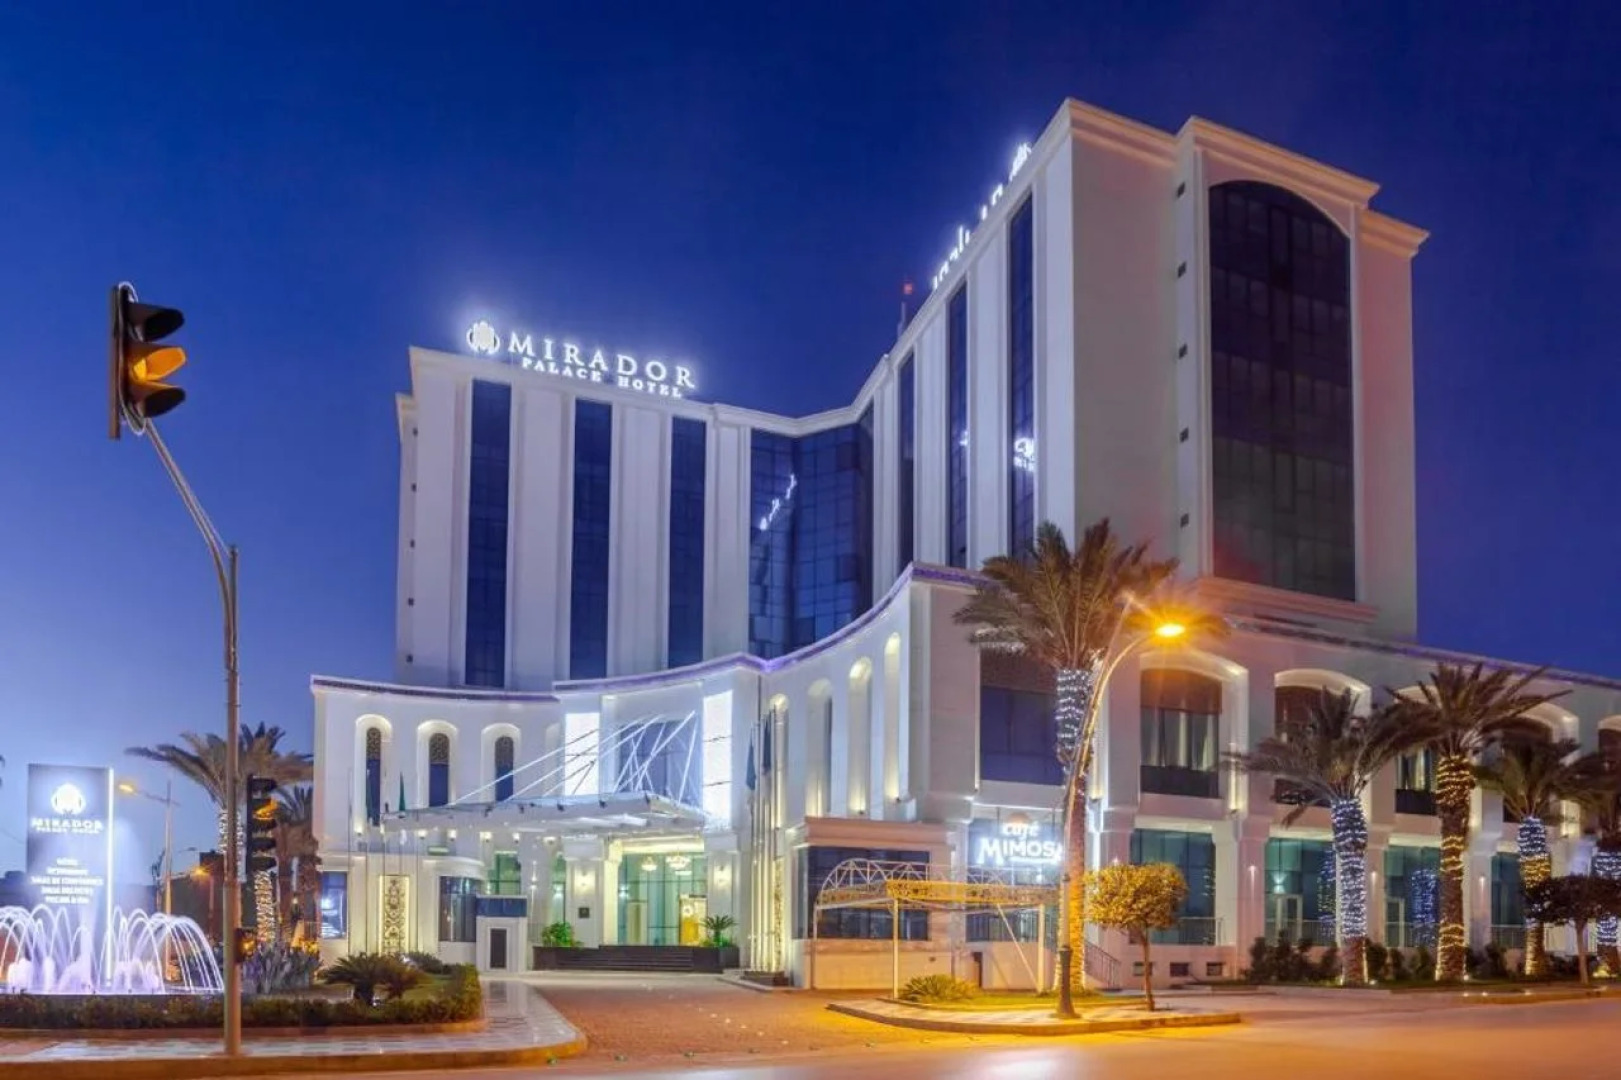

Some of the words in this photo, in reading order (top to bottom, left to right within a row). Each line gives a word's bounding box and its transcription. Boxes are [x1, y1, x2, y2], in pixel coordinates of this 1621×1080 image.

[508, 330, 695, 389] MIRADOR
[522, 357, 602, 383] PALACE
[617, 376, 682, 399] HOTEL
